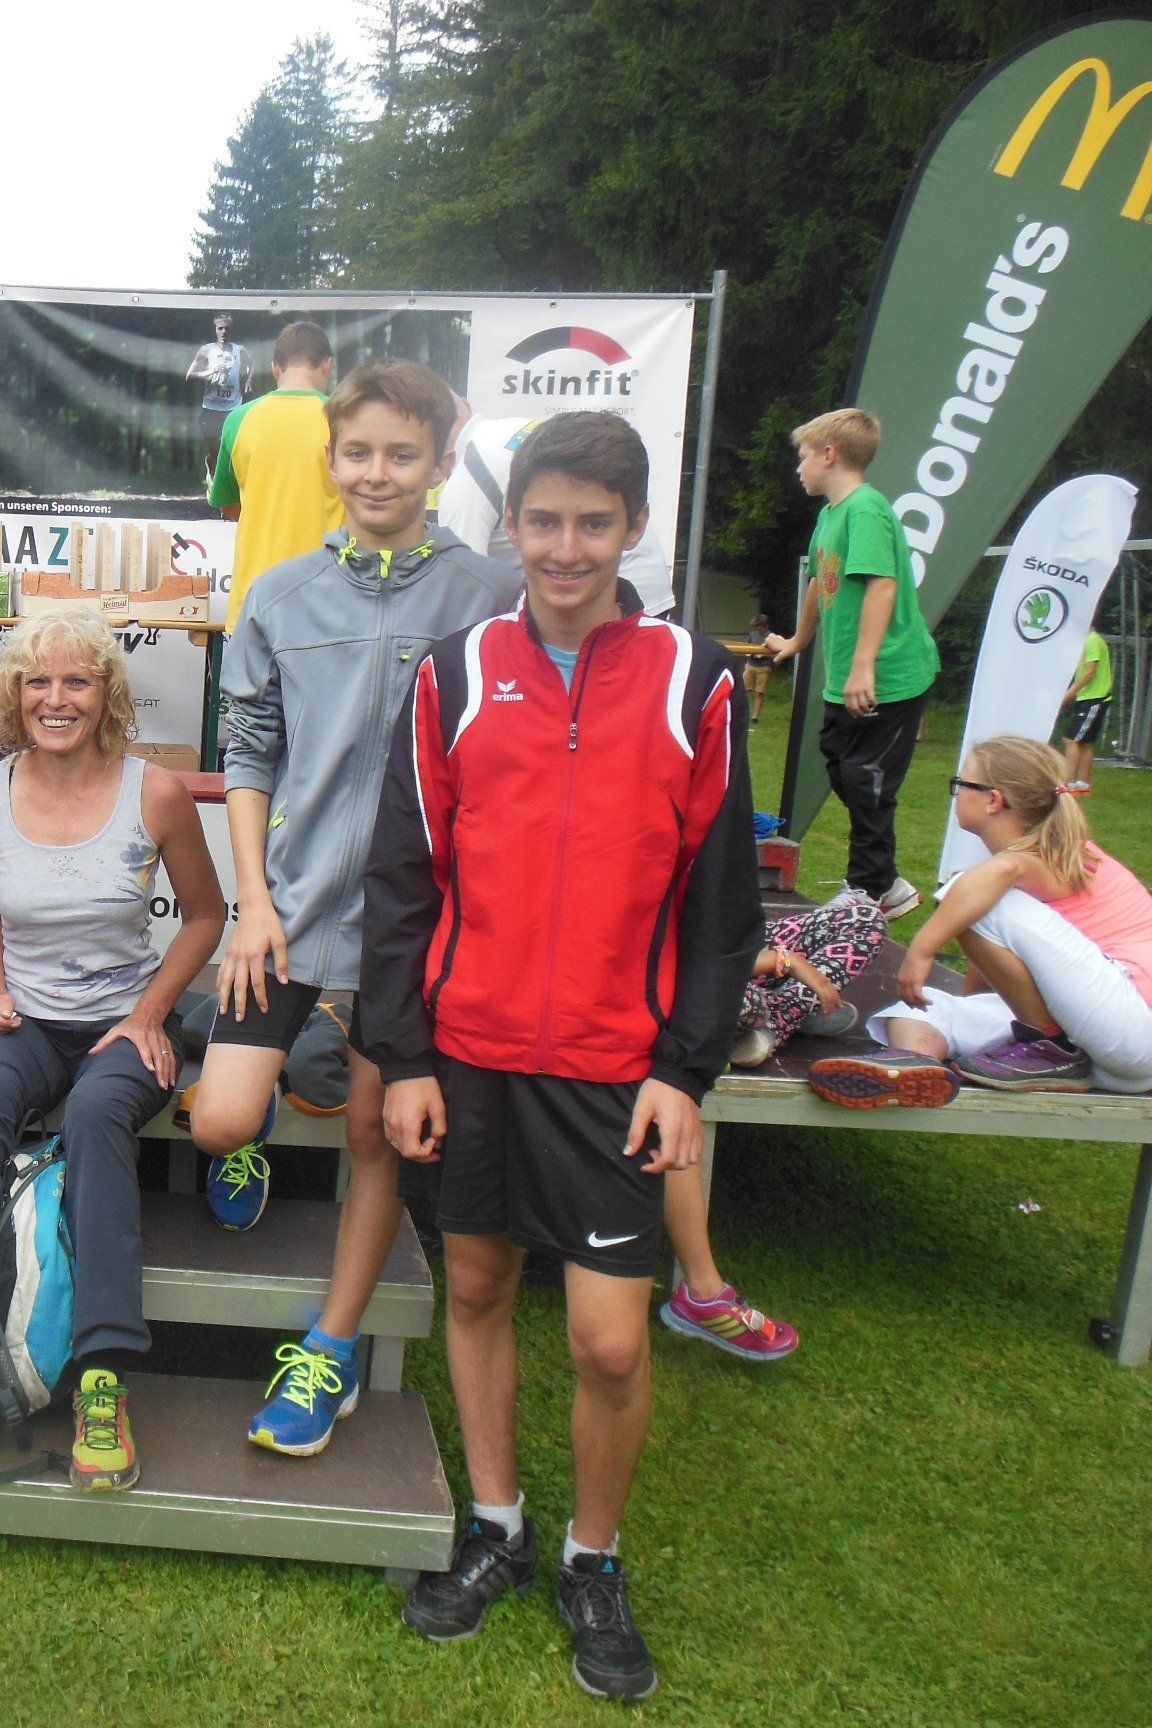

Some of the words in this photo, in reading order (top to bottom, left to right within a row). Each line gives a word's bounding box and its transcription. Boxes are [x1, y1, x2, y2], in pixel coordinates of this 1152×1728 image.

[502, 369, 632, 396] skinfit
[6, 502, 49, 512] unseren
[51, 501, 112, 514] Sponsoren:
[1022, 555, 1090, 588] ŠKODA
[492, 692, 524, 702] erima
